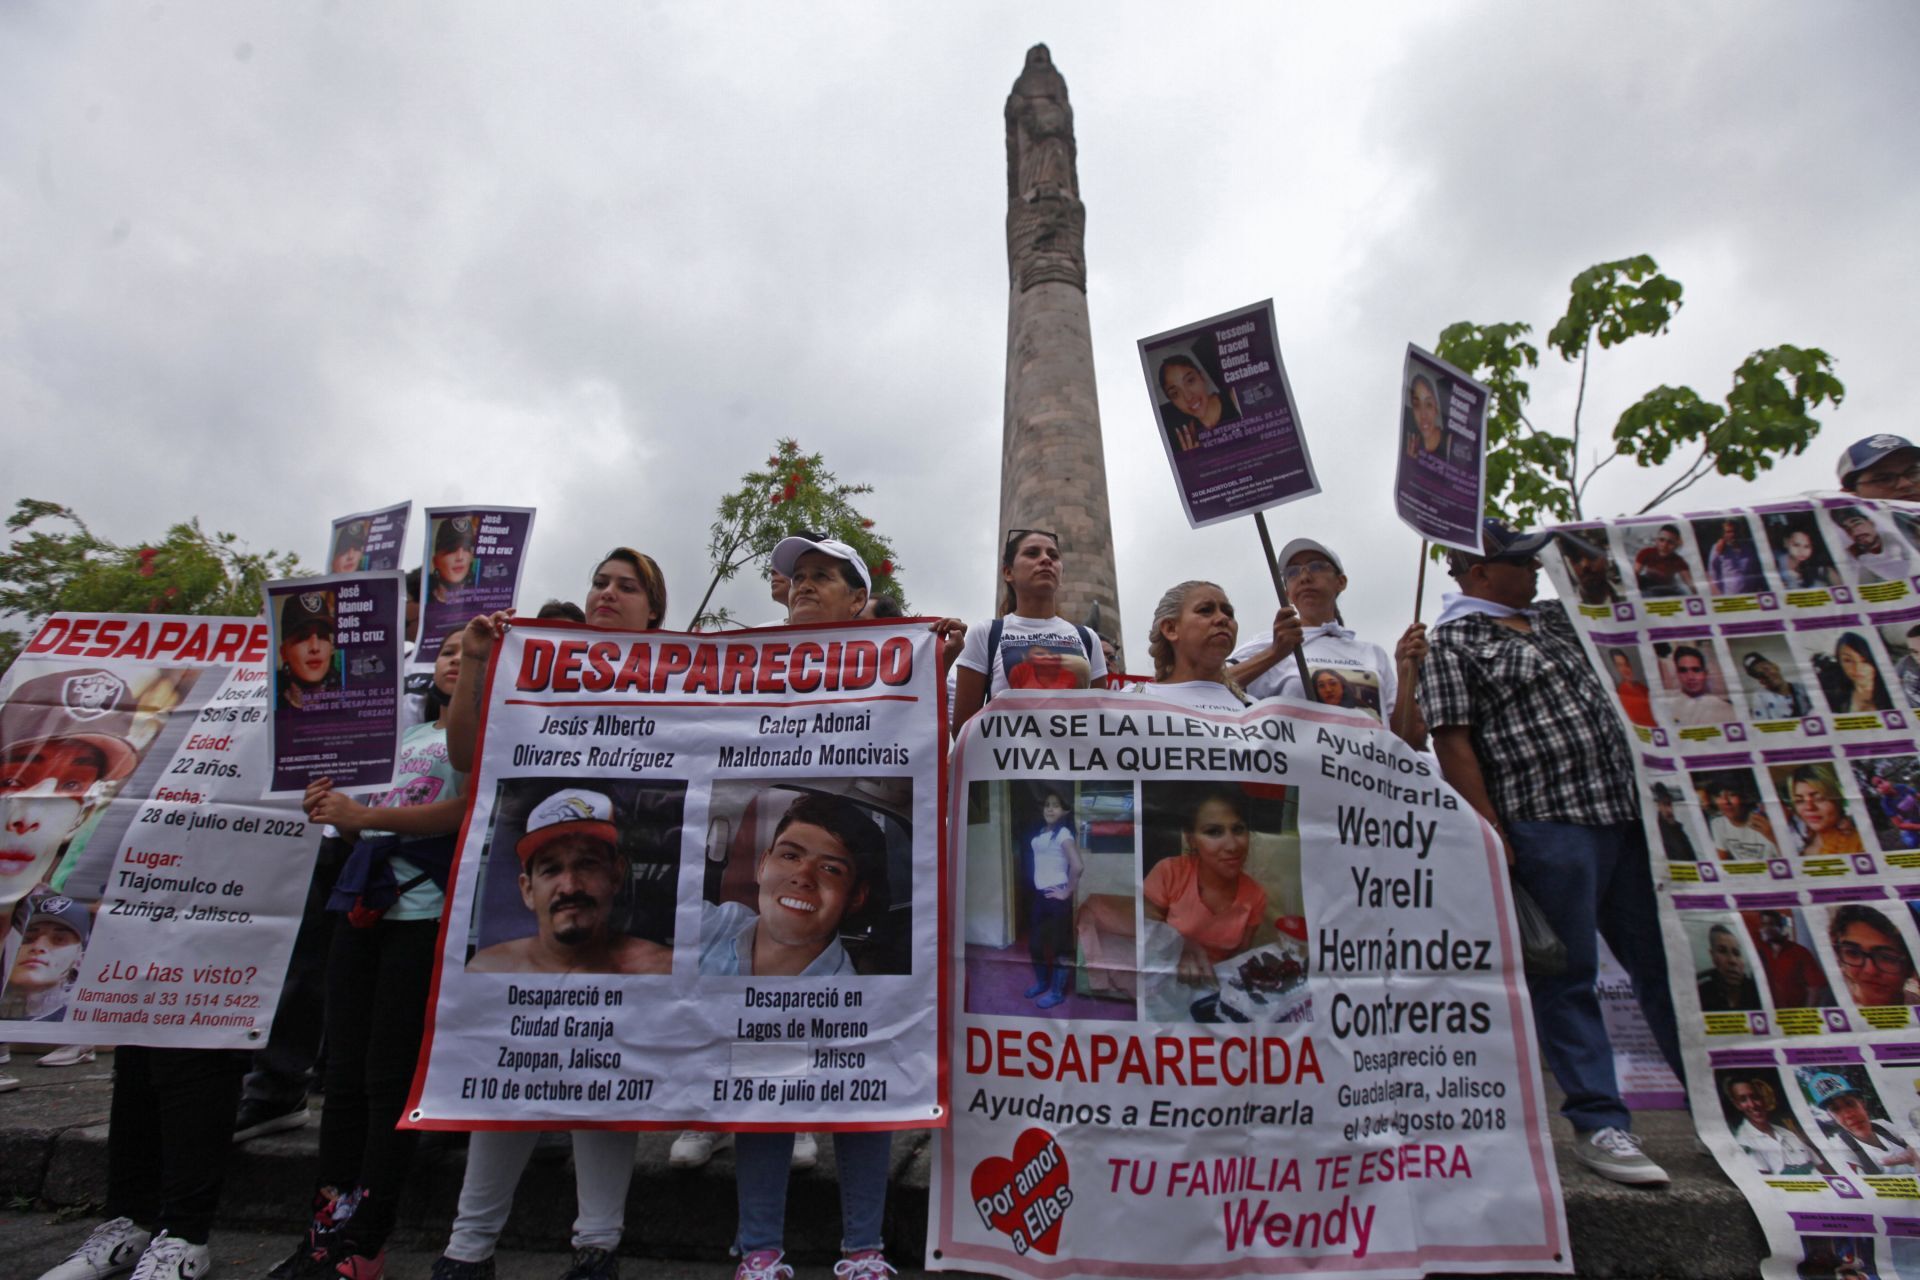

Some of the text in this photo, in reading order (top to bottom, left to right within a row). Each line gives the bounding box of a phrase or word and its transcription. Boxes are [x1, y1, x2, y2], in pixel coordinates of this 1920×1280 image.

[1215, 320, 1255, 341] Yessenia
[1218, 335, 1249, 355] Araceli
[1220, 352, 1250, 370] Gómez
[1223, 360, 1270, 383] Castañeda
[480, 524, 510, 535] Manuel
[476, 546, 514, 556] de la cruz
[338, 584, 360, 599] José
[338, 599, 373, 614] Manuel
[337, 630, 385, 644] de la cruz
[515, 636, 914, 695] DESAPARECIDO
[241, 706, 261, 723] de
[539, 714, 656, 736] Jesús Alberto
[759, 709, 871, 738] Calep Adonai
[980, 713, 1297, 744] VIVA SE LA LLEVARON
[186, 734, 233, 752] Edad:
[718, 742, 910, 768] Maldonado Moncivais
[1316, 726, 1431, 777] Ayudanos
[171, 757, 242, 778] 22 años.
[513, 744, 675, 772] Olivares Rodríguez
[992, 746, 1289, 775] VIVA LA QUEREMOS
[156, 787, 206, 804] Fecha:
[1321, 754, 1459, 811] Encontrarla
[141, 808, 305, 838] 28 de julio del 2022
[1337, 804, 1438, 860] Wendy
[124, 847, 183, 869] Lugar:
[119, 871, 244, 896] Tlajomulco de
[1351, 866, 1433, 908] Yareli
[109, 899, 254, 924] Zuñiga, Jalisco.
[1318, 928, 1492, 972] Hernández
[97, 960, 257, 985] ¿Lo has visto?
[77, 988, 139, 1004] llamanos
[143, 991, 155, 1004] al
[159, 992, 178, 1006] 33
[185, 993, 219, 1008] 1514
[508, 985, 623, 1009] Desapareció en
[745, 986, 863, 1012] Desapareció en
[73, 1008, 255, 1028] tu llamada sera Anonima
[511, 1015, 614, 1041] Ciudad Granja
[1331, 992, 1491, 1039] Contreras
[737, 1018, 868, 1041] Lagos de Moreno
[497, 1046, 621, 1072] Zapopan, Jalisco
[813, 1048, 866, 1069] Jalisco
[965, 1026, 1325, 1086] DESAPARECIDA
[1354, 1045, 1477, 1073] Desapareció en
[461, 1077, 654, 1101] El 10 de octubre del 2017
[713, 1079, 887, 1105] El 26 de julio del 2021
[1338, 1076, 1506, 1108] Guadalaara, Jalisco
[968, 1088, 1314, 1128] Ayudanos a Encontrarla
[1344, 1116, 1359, 1141] el
[1373, 1113, 1388, 1135] de
[1461, 1108, 1506, 1130] 2018
[976, 1140, 1060, 1231] Por amor
[1107, 1158, 1157, 1196] TU
[1166, 1155, 1303, 1198] FAMILIA
[1315, 1155, 1352, 1192] TE
[1012, 1184, 1074, 1256] a Ellas
[1223, 1195, 1376, 1259] Wendy
